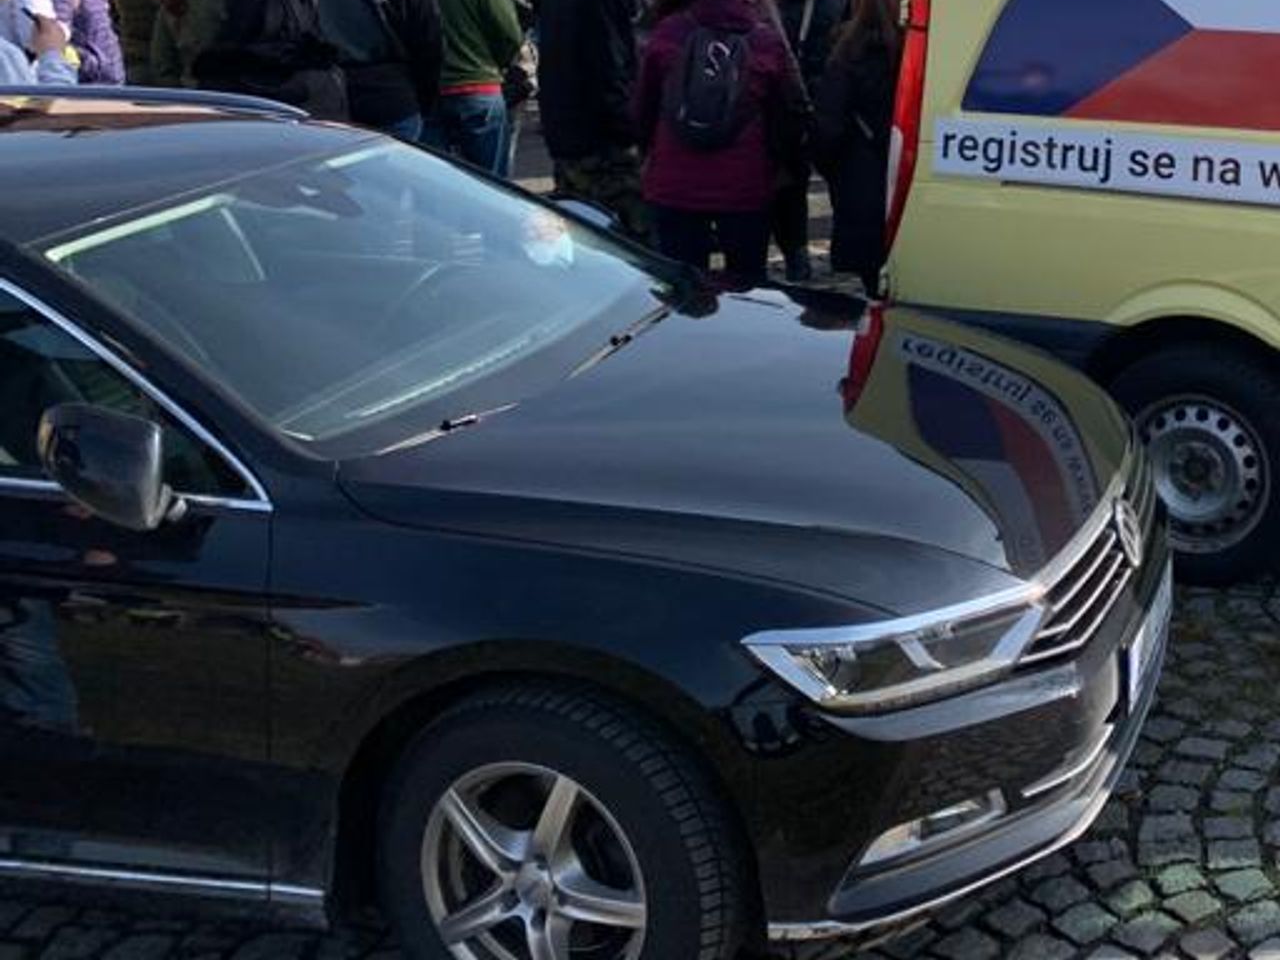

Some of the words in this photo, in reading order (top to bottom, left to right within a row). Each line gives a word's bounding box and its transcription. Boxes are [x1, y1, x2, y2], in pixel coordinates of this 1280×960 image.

[941, 130, 1113, 183] registruj
[1127, 147, 1177, 180] se
[1191, 153, 1242, 186] na
